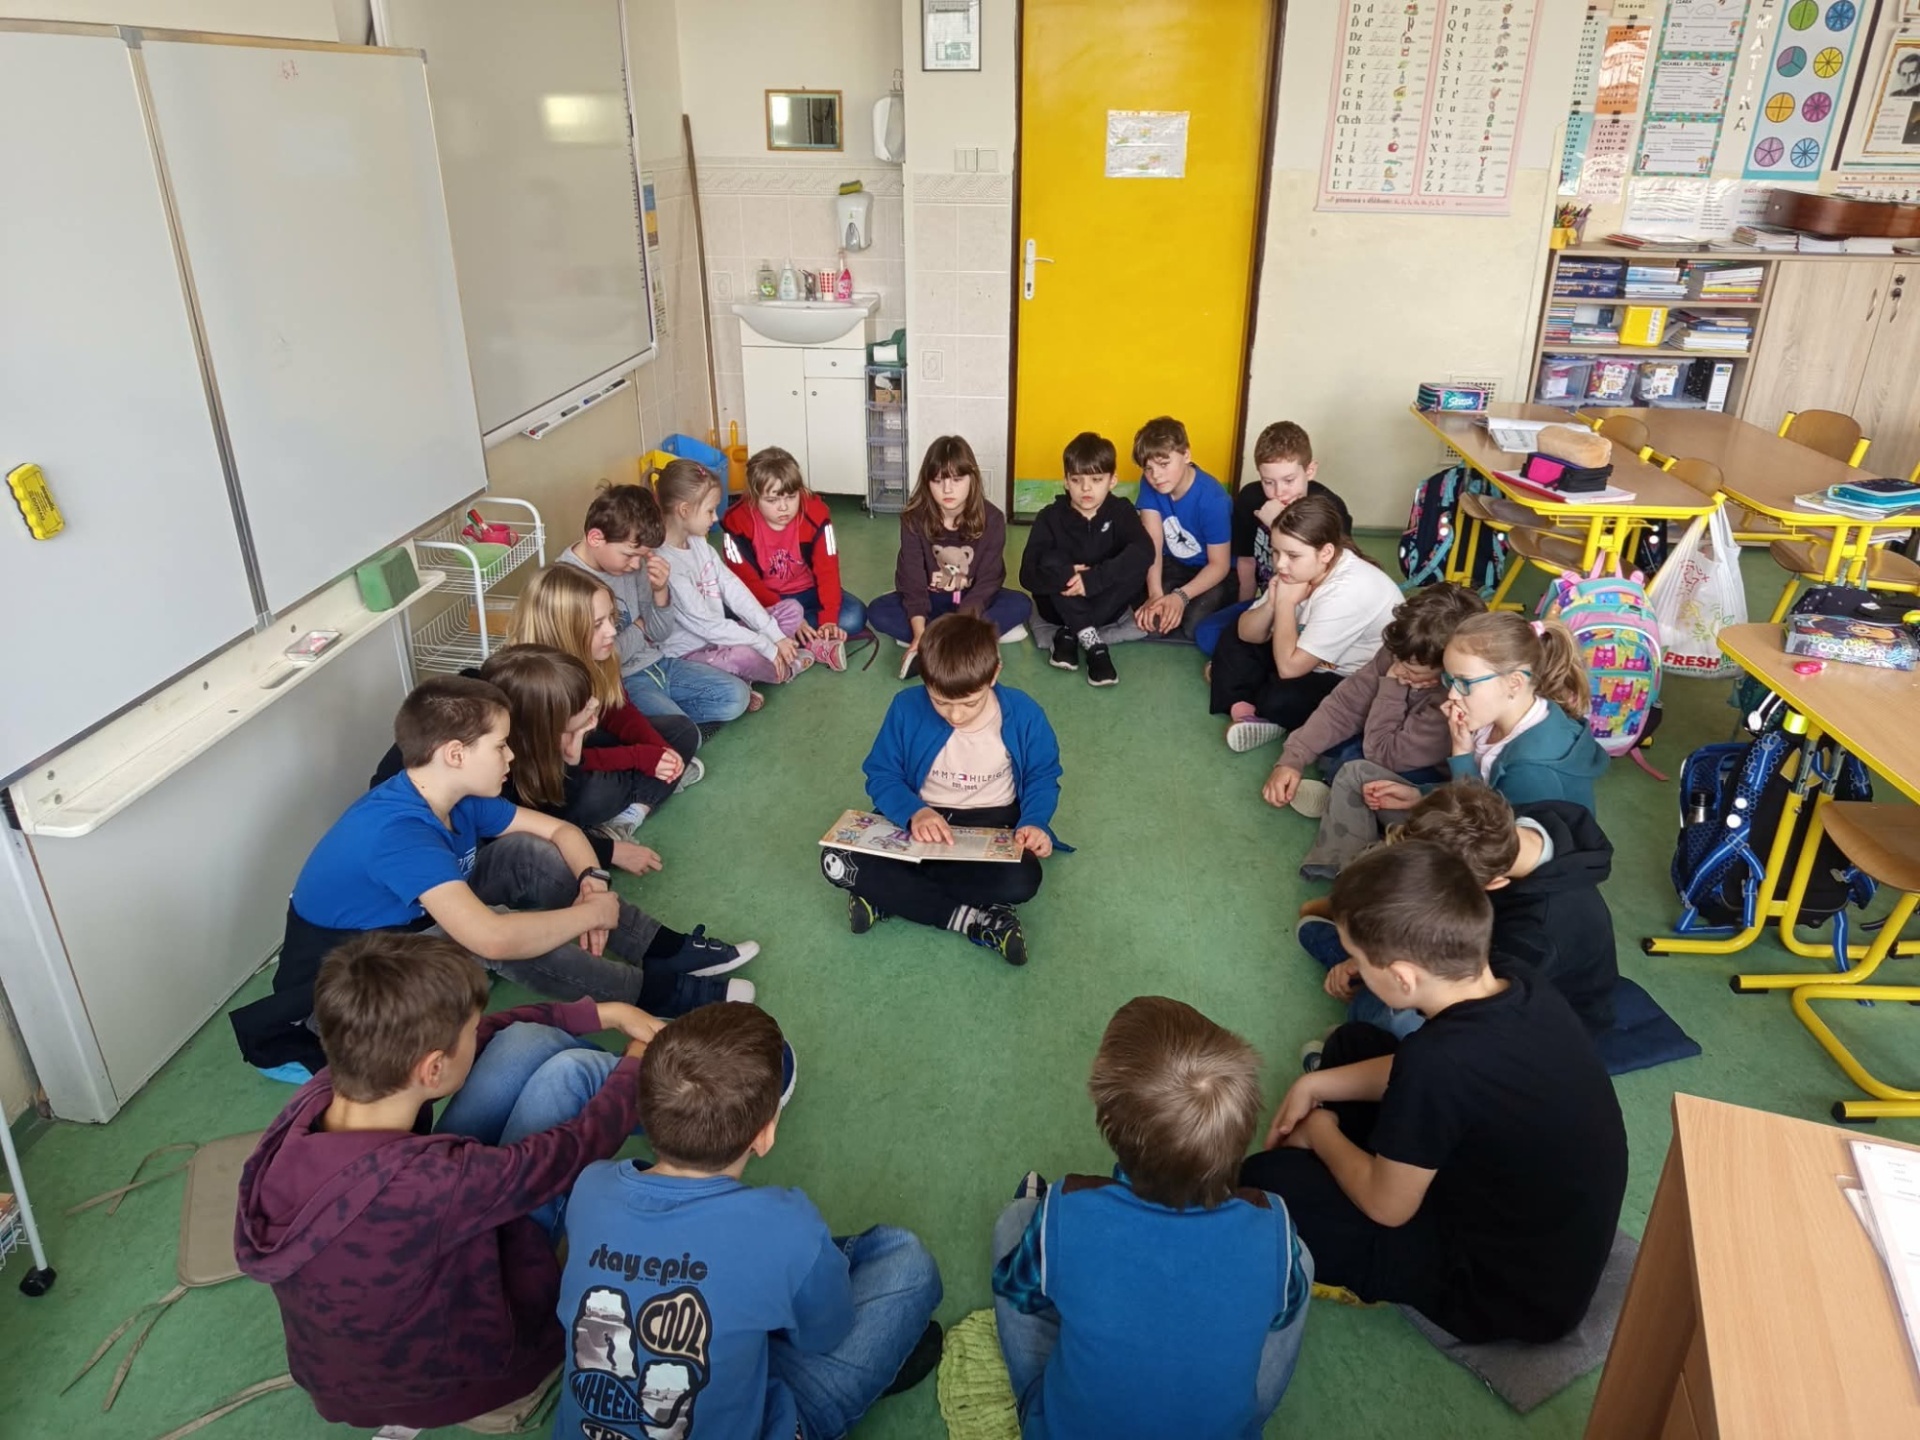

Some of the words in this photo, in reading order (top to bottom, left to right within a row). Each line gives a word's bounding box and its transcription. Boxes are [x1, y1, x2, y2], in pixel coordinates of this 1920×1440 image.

[1353, 4, 1361, 13] D
[1367, 4, 1373, 13] d
[1451, 5, 1458, 14] P
[1464, 8, 1471, 17] p
[1448, 19, 1456, 31] Q
[1462, 22, 1469, 32] q
[1350, 32, 1362, 41] Dz
[1446, 34, 1454, 43] R
[1444, 48, 1451, 57] S
[1346, 60, 1354, 69] E
[1346, 74, 1353, 83] F
[1360, 74, 1365, 83] f
[1440, 76, 1448, 85] T
[1456, 77, 1459, 85] t
[1343, 88, 1351, 97] G
[1357, 90, 1363, 99] g
[1342, 101, 1349, 110] H
[1356, 101, 1361, 110] h
[1436, 103, 1444, 112] U
[1337, 115, 1350, 124] Ch
[1351, 115, 1361, 124] ch
[1434, 117, 1442, 125] V
[1340, 128, 1344, 137] I
[1431, 130, 1442, 139] W
[1337, 141, 1343, 150] J
[1430, 144, 1438, 152] X
[1335, 154, 1343, 163] K
[1349, 155, 1355, 163] k
[1429, 157, 1437, 166] Y
[1441, 160, 1448, 168] y
[1334, 168, 1341, 176] L
[1426, 170, 1434, 179] Z
[33, 496, 46, 521] DONAU
[1663, 652, 1721, 669] FRESH
[932, 769, 956, 780] MMY
[970, 770, 1003, 782] HILFIG
[589, 1243, 642, 1282] stay
[643, 1252, 708, 1286] epic
[642, 1297, 704, 1357] COOL
[575, 1372, 645, 1420] WHEELIE
